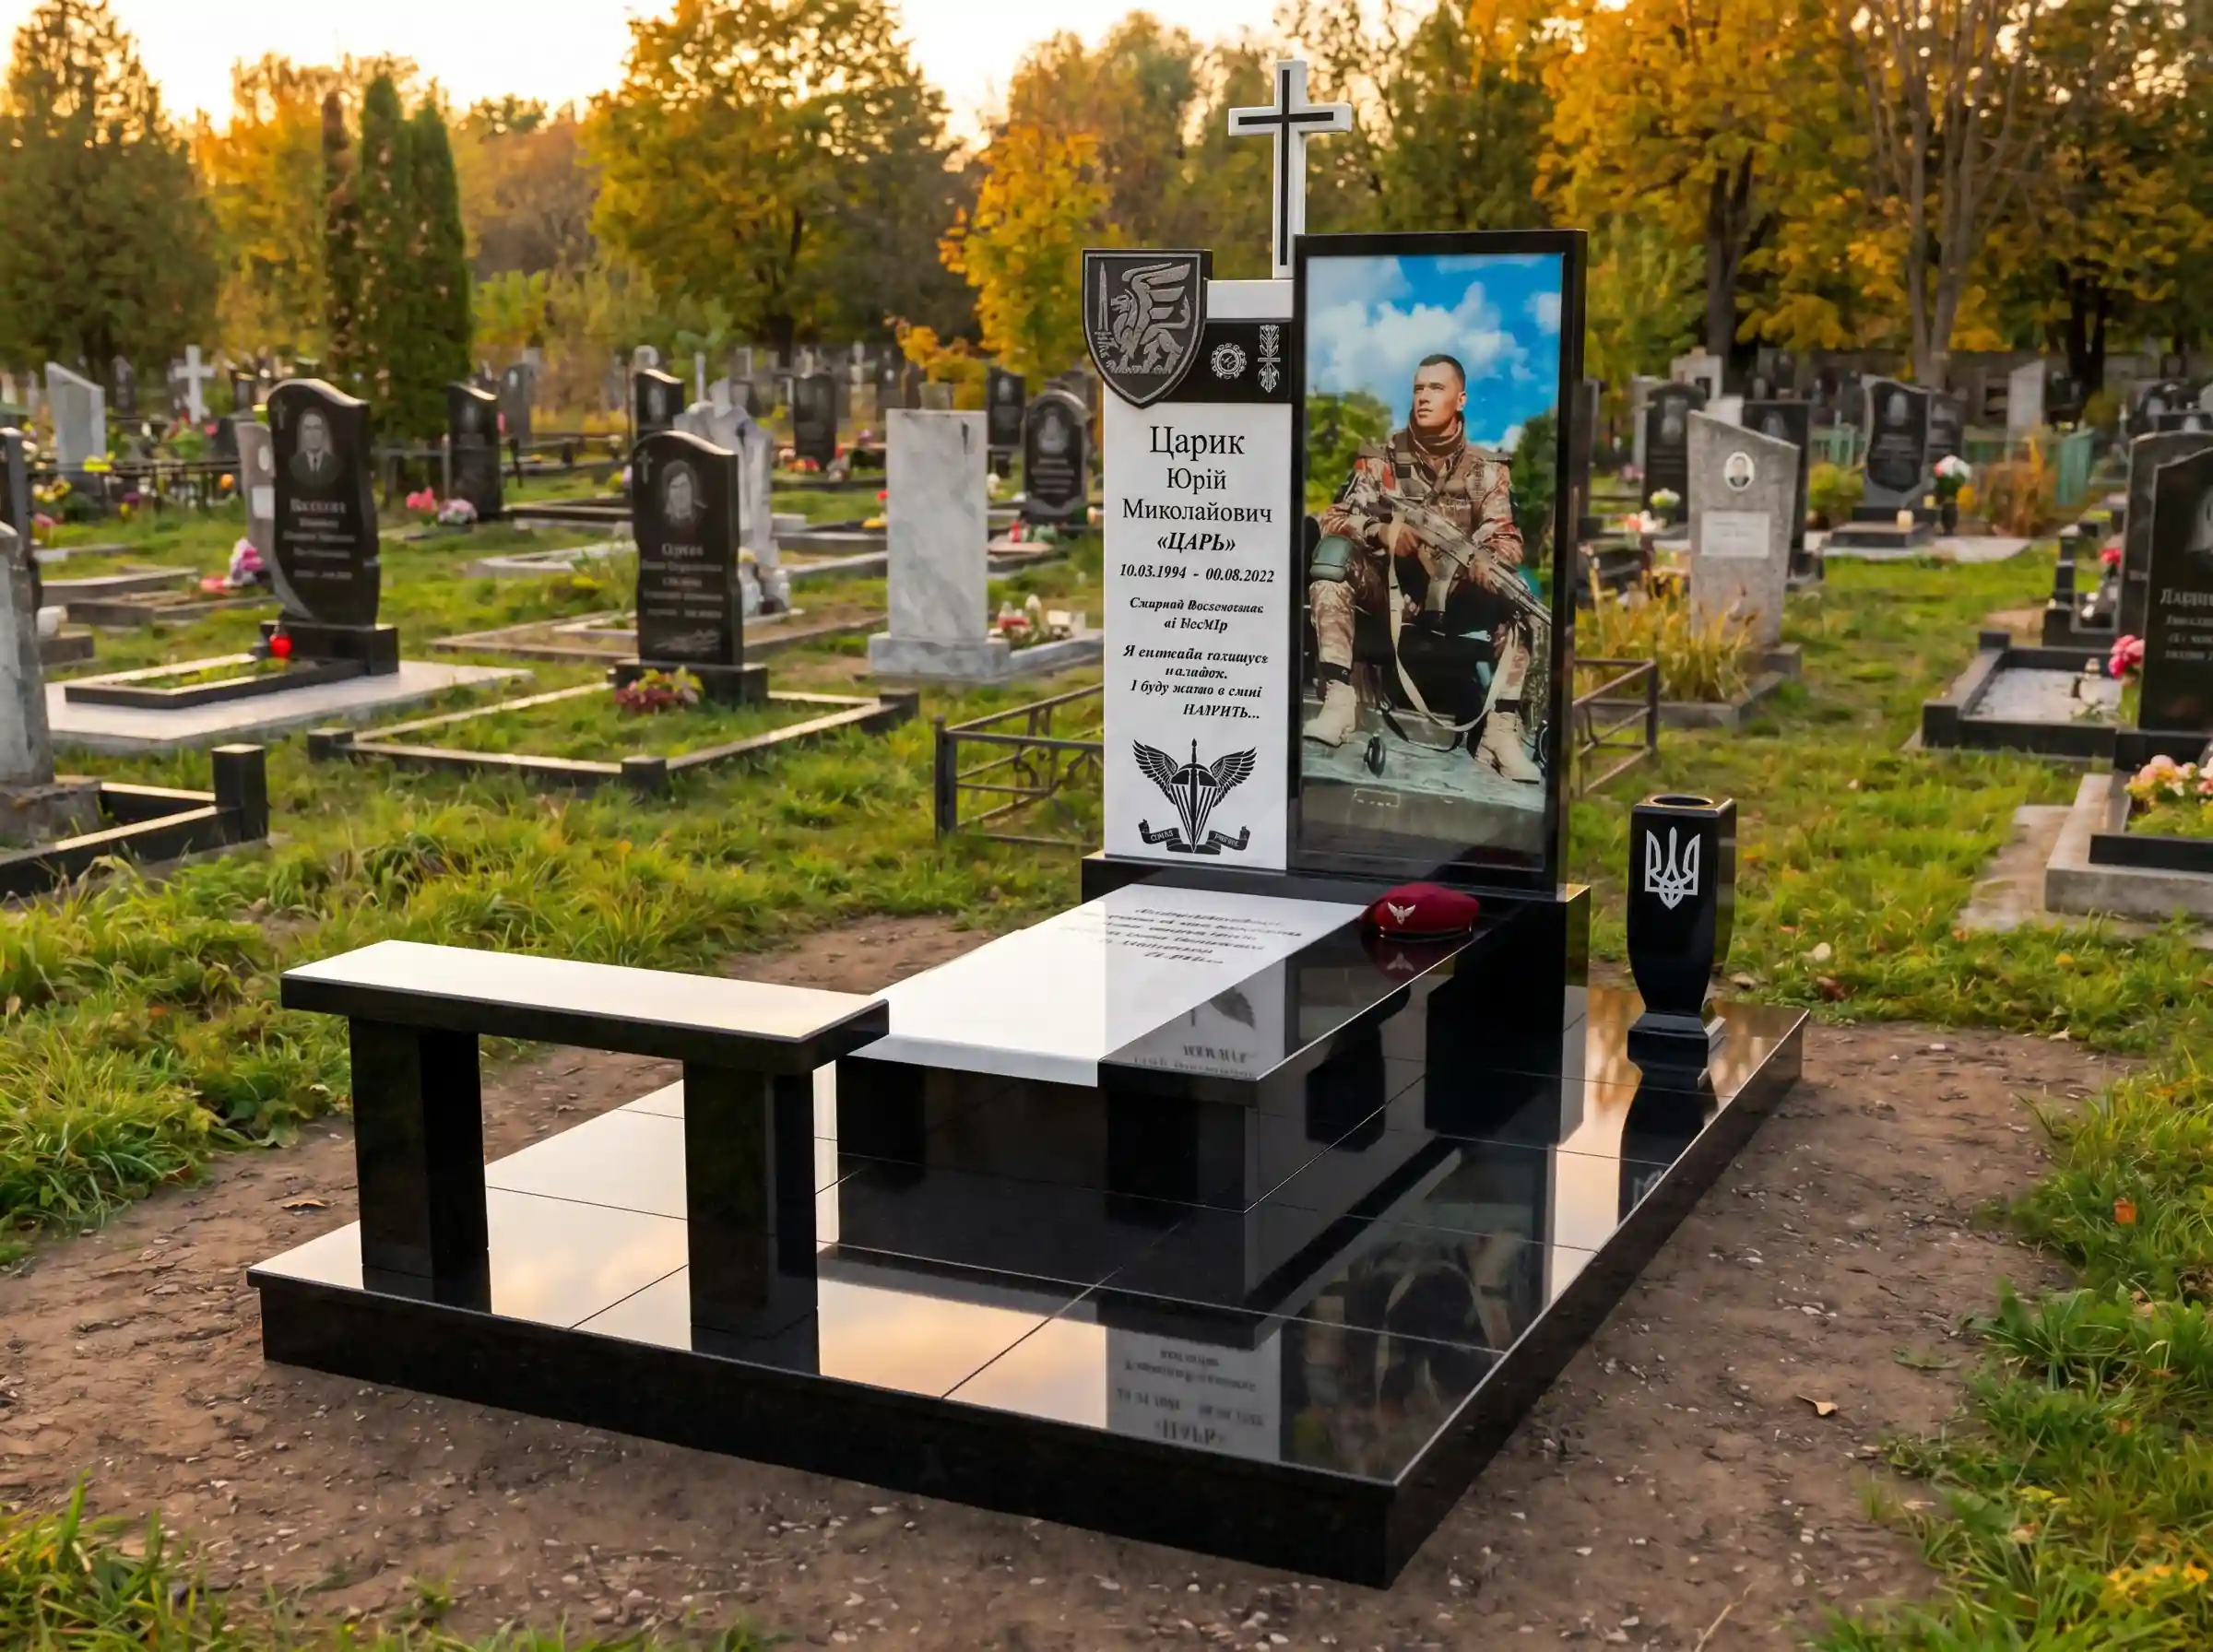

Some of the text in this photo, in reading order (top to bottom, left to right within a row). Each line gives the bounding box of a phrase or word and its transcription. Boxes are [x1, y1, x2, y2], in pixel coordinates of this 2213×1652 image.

[1149, 425, 1246, 462] Царик
[1166, 467, 1227, 495] Юрій
[1122, 498, 1272, 523] Миколайович
[1156, 532, 1237, 554] «ЦАРЬ»
[1119, 563, 1187, 579] 10.03.1994
[1205, 567, 1275, 584] 00.08.2022
[1122, 644, 1136, 657] Я
[1140, 680, 1169, 696] буду
